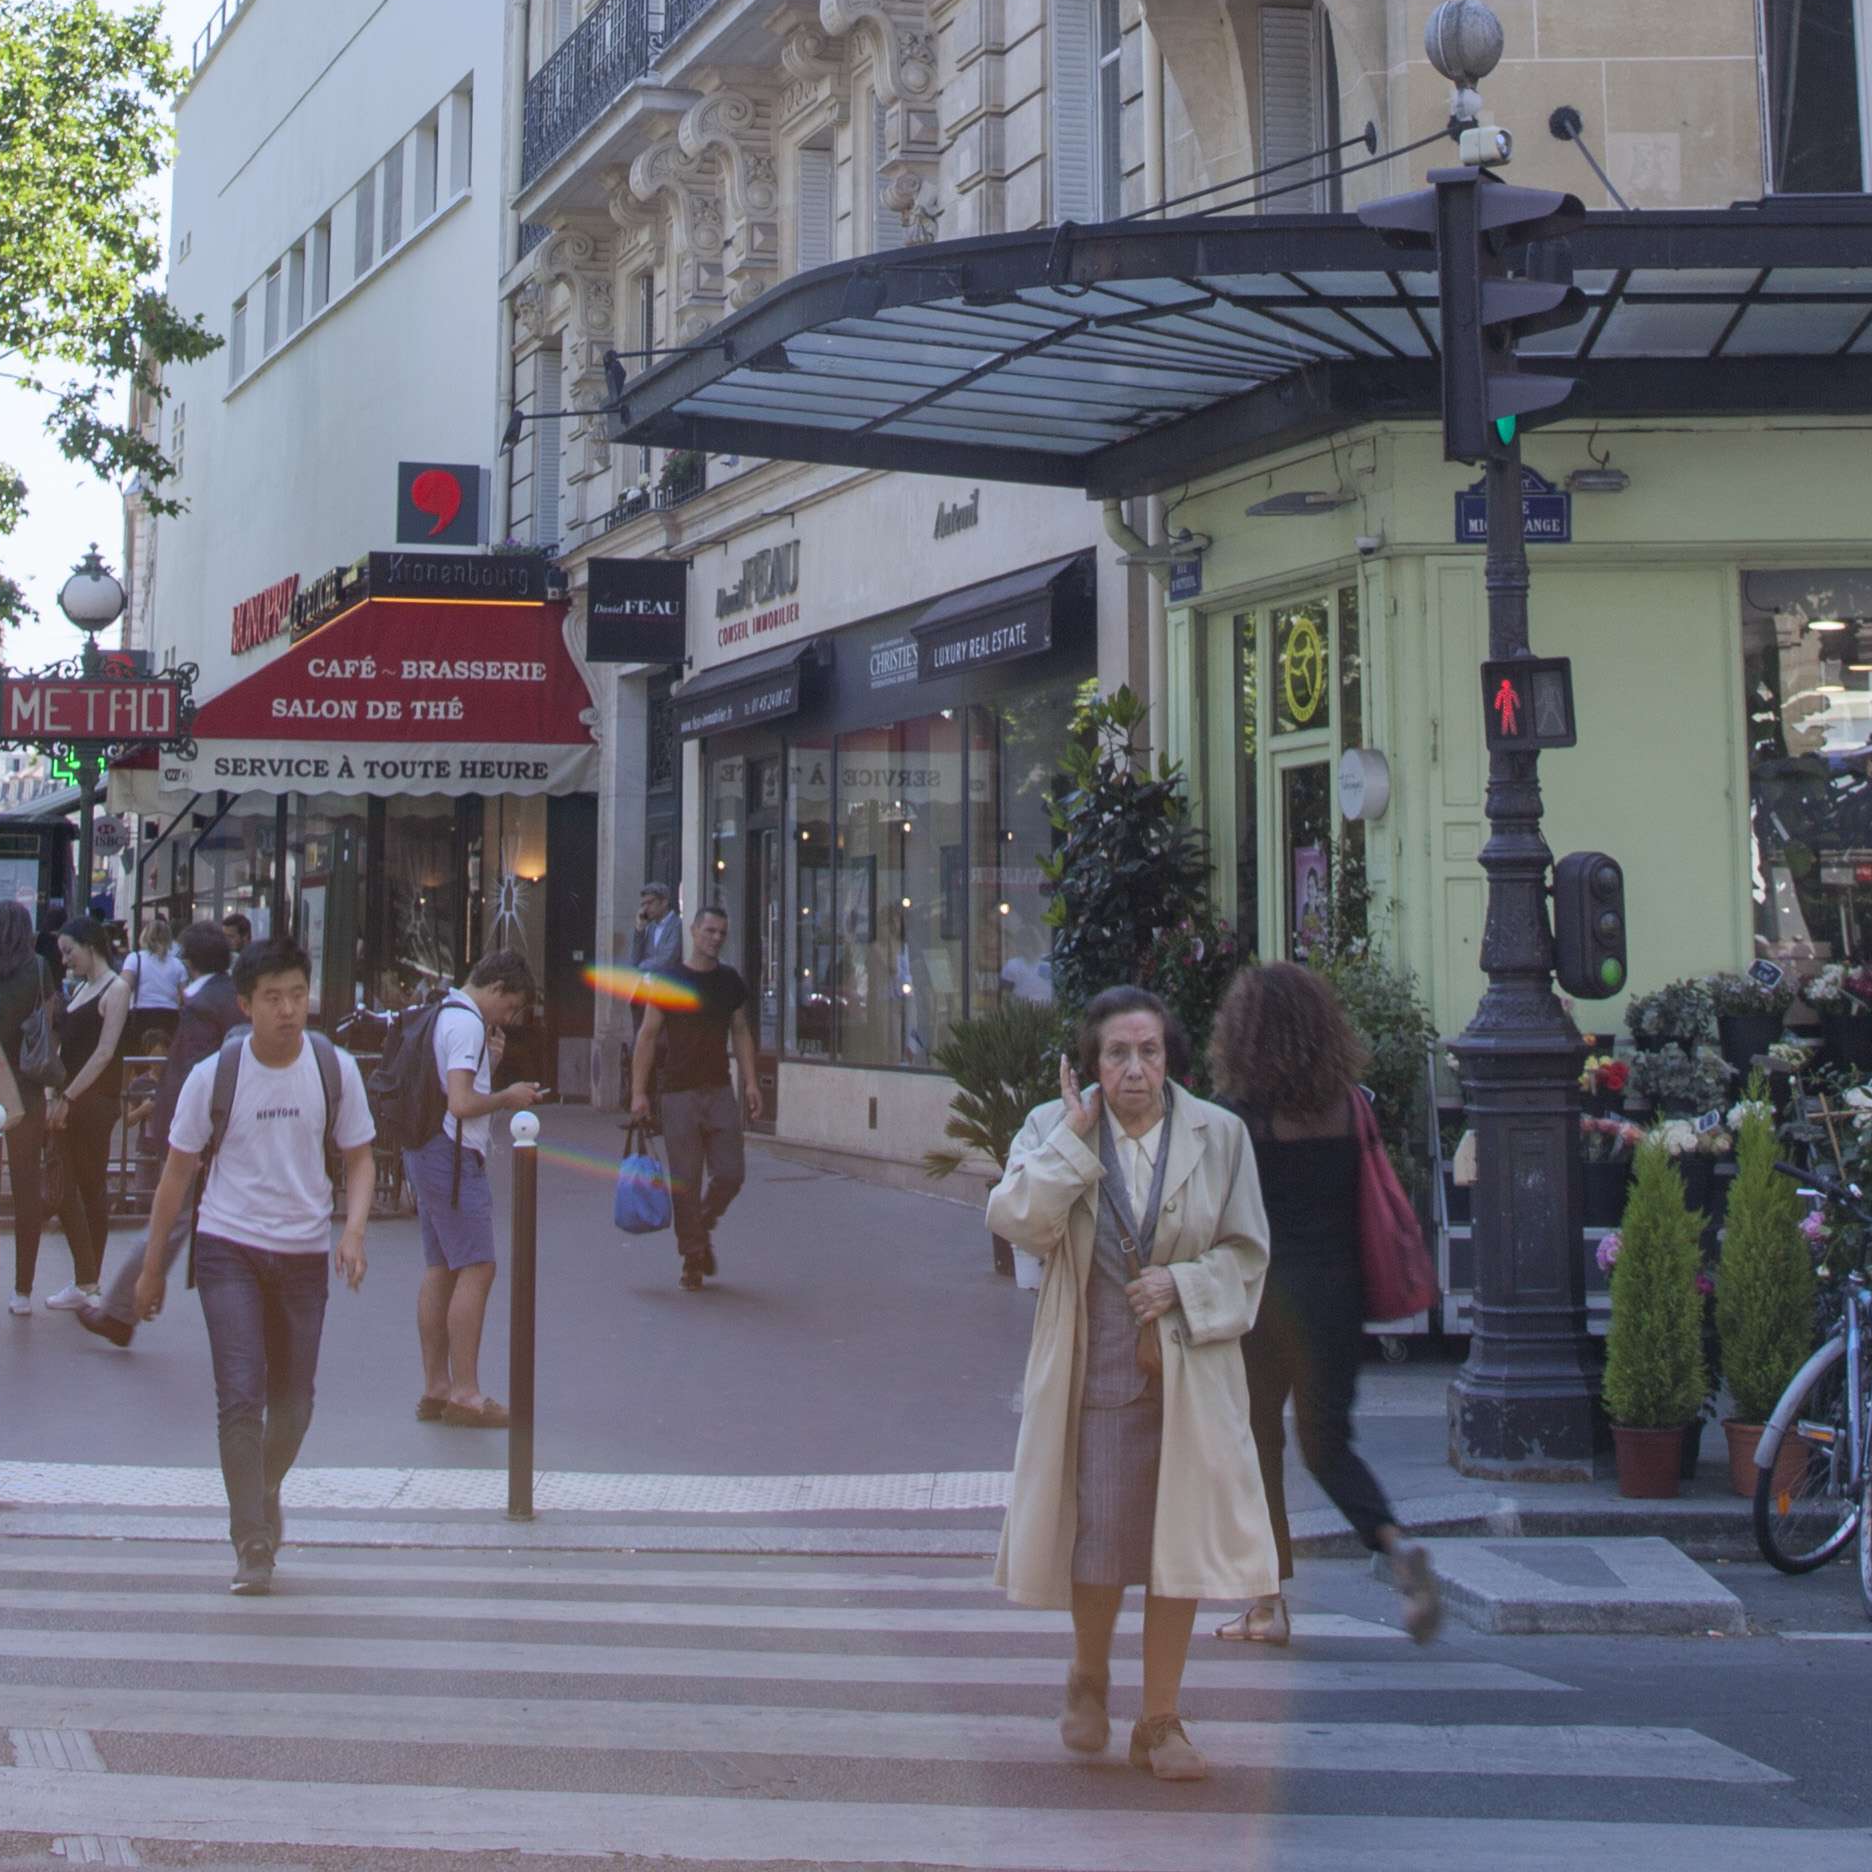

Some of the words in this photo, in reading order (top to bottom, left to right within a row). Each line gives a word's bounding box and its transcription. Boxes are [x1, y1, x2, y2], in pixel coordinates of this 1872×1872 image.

[387, 554, 529, 595] Kronenbourg
[741, 539, 801, 606] FEAU
[625, 600, 680, 615] FEAU
[718, 619, 750, 648] CONSEIL
[752, 602, 801, 634] IMMOBILIER
[933, 641, 967, 668] LUXURY
[969, 634, 990, 658] REAL
[992, 622, 1027, 652] ESTATE
[308, 656, 377, 678] CAFÉ
[401, 660, 547, 682] BRASSERIE
[272, 700, 357, 719] SALON
[366, 701, 402, 720] DE
[410, 697, 464, 720] THÉ
[214, 758, 329, 778] SERVICE
[337, 755, 355, 778] À
[364, 761, 451, 780] TOUTE
[459, 762, 549, 780] HEURE
